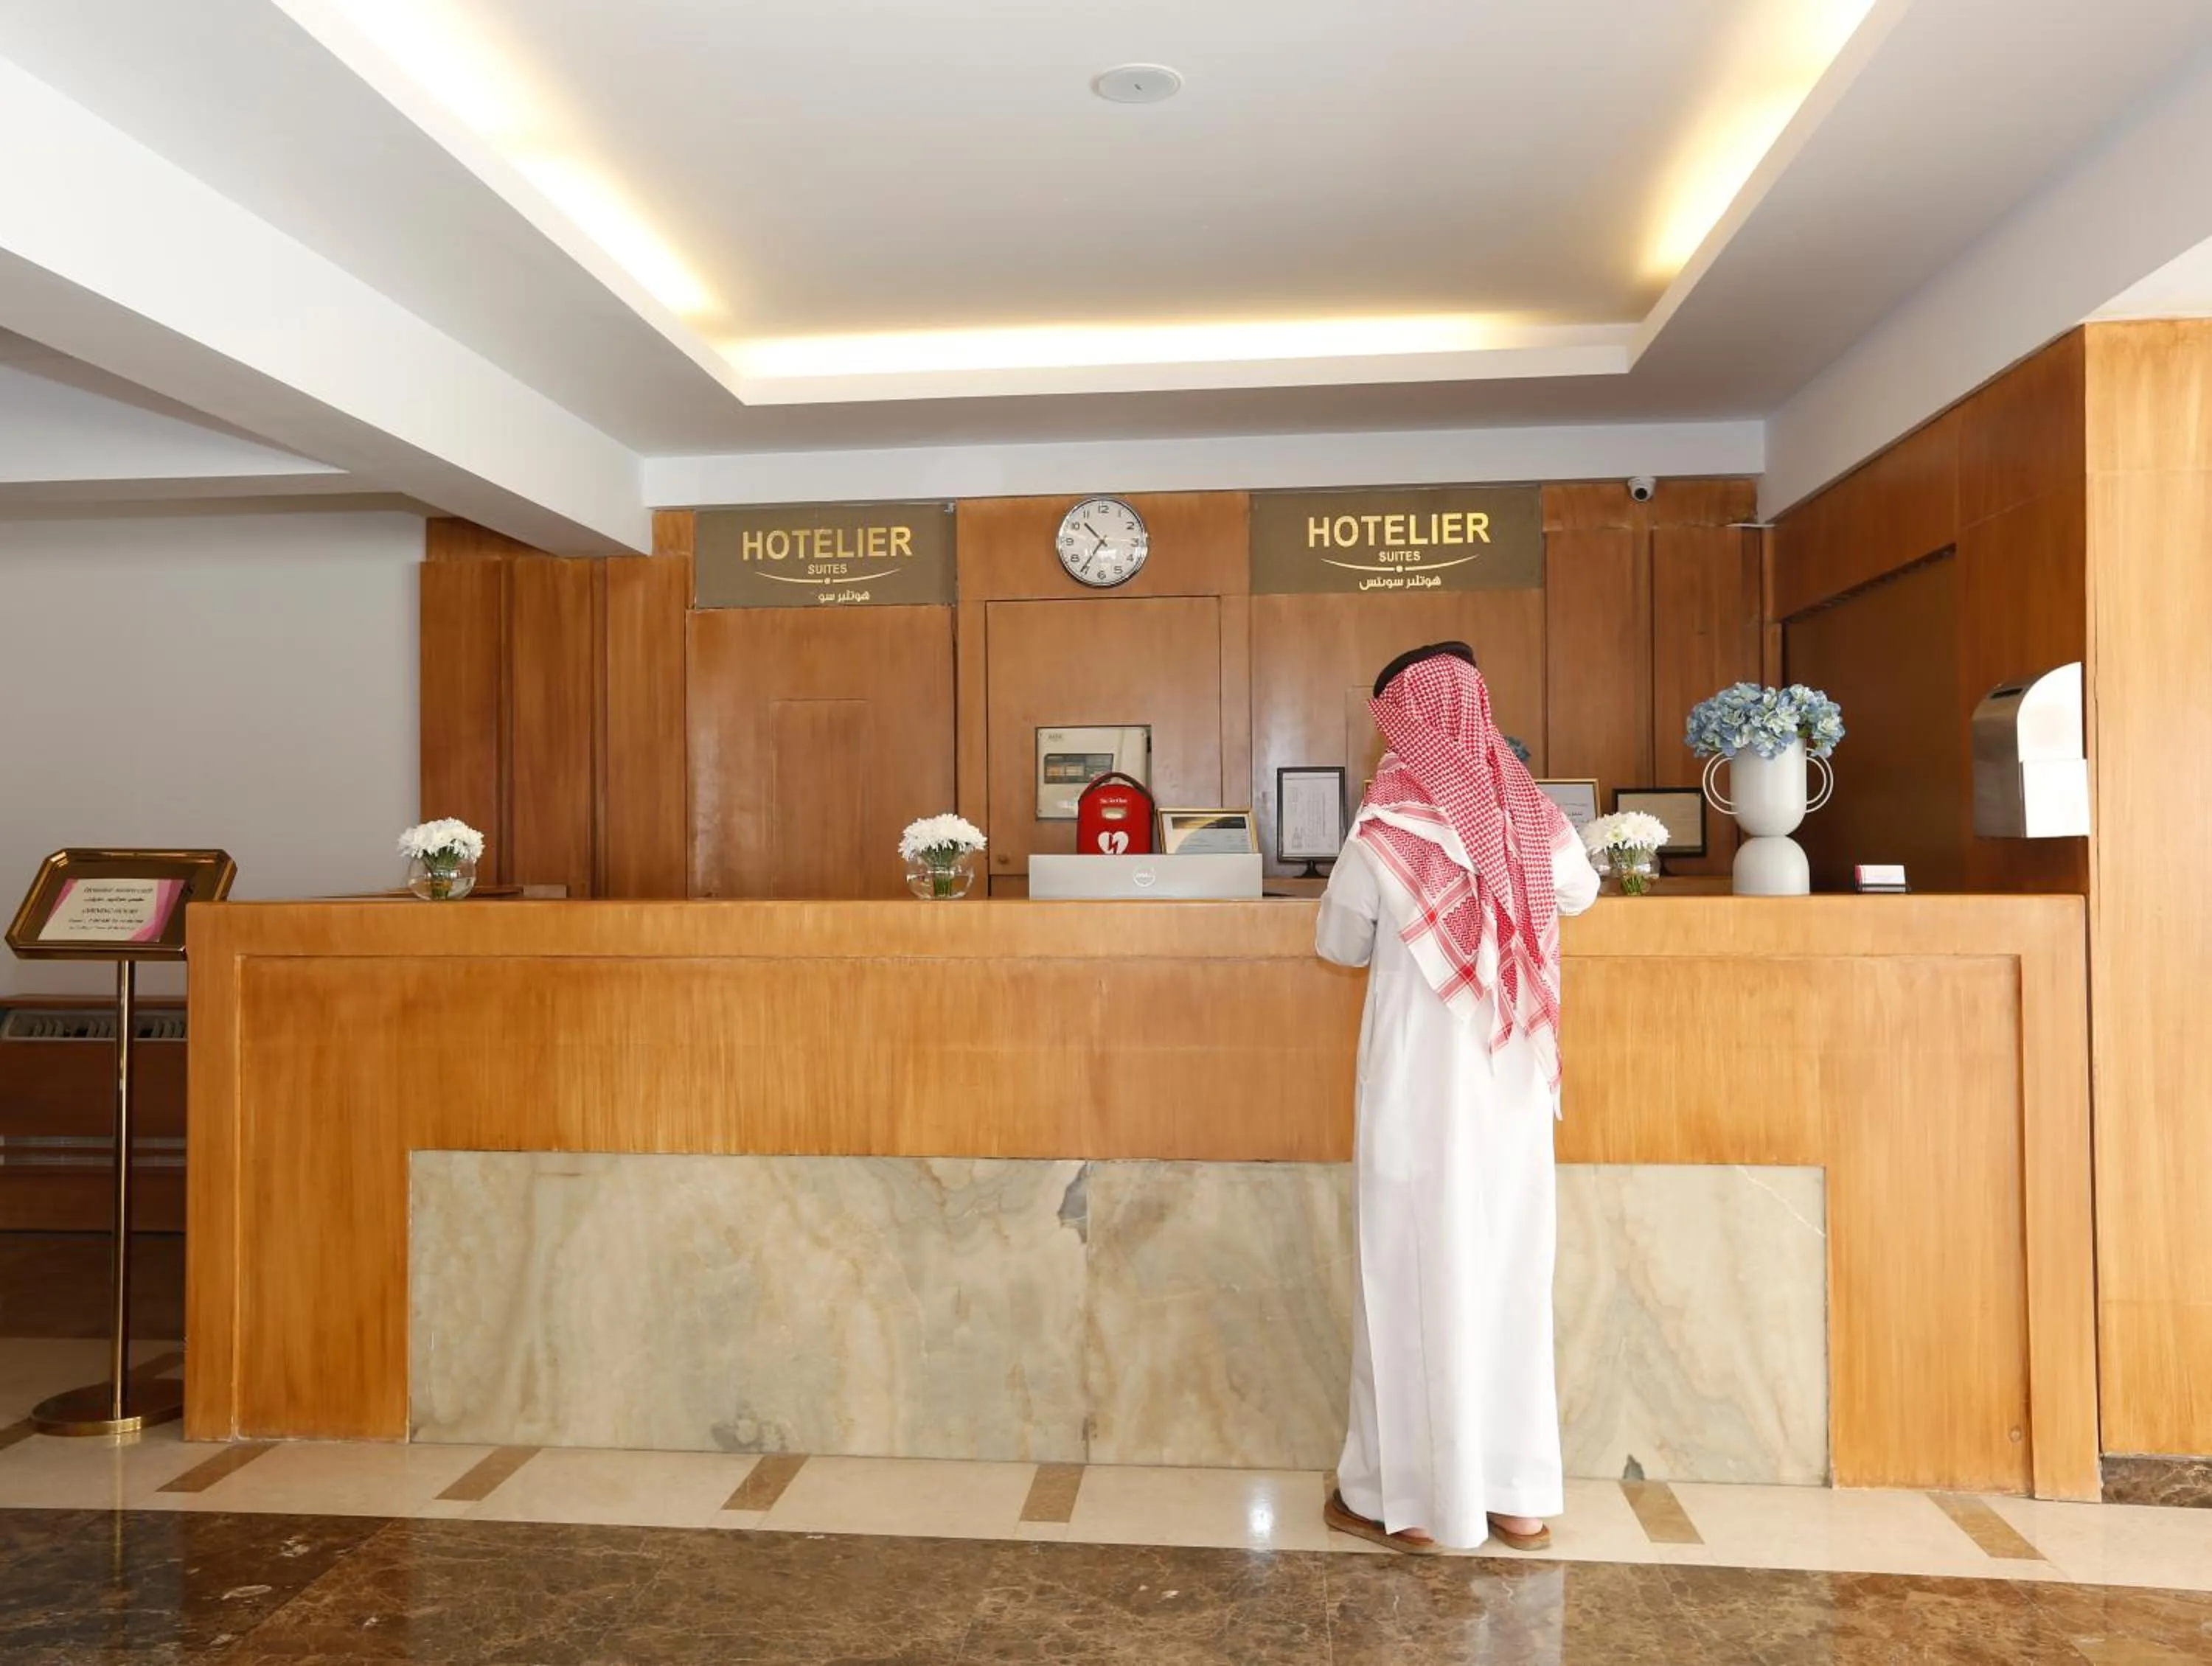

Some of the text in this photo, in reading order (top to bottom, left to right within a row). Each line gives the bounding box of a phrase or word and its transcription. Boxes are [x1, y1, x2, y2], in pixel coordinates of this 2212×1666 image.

[1083, 509, 1090, 519] 11
[1098, 505, 1109, 514] 12
[1071, 521, 1080, 530] 10
[1126, 521, 1135, 530] 2
[1308, 512, 1491, 548] HOTELIER
[742, 526, 913, 561] HOTELIER
[1066, 537, 1074, 546] 9
[1130, 537, 1139, 547] 3
[1071, 554, 1080, 562] 8
[1126, 554, 1134, 562] 4
[1378, 551, 1421, 562] SUITES
[807, 563, 847, 575] SUITES
[1114, 565, 1123, 574] 5
[1097, 571, 1106, 580] 6
